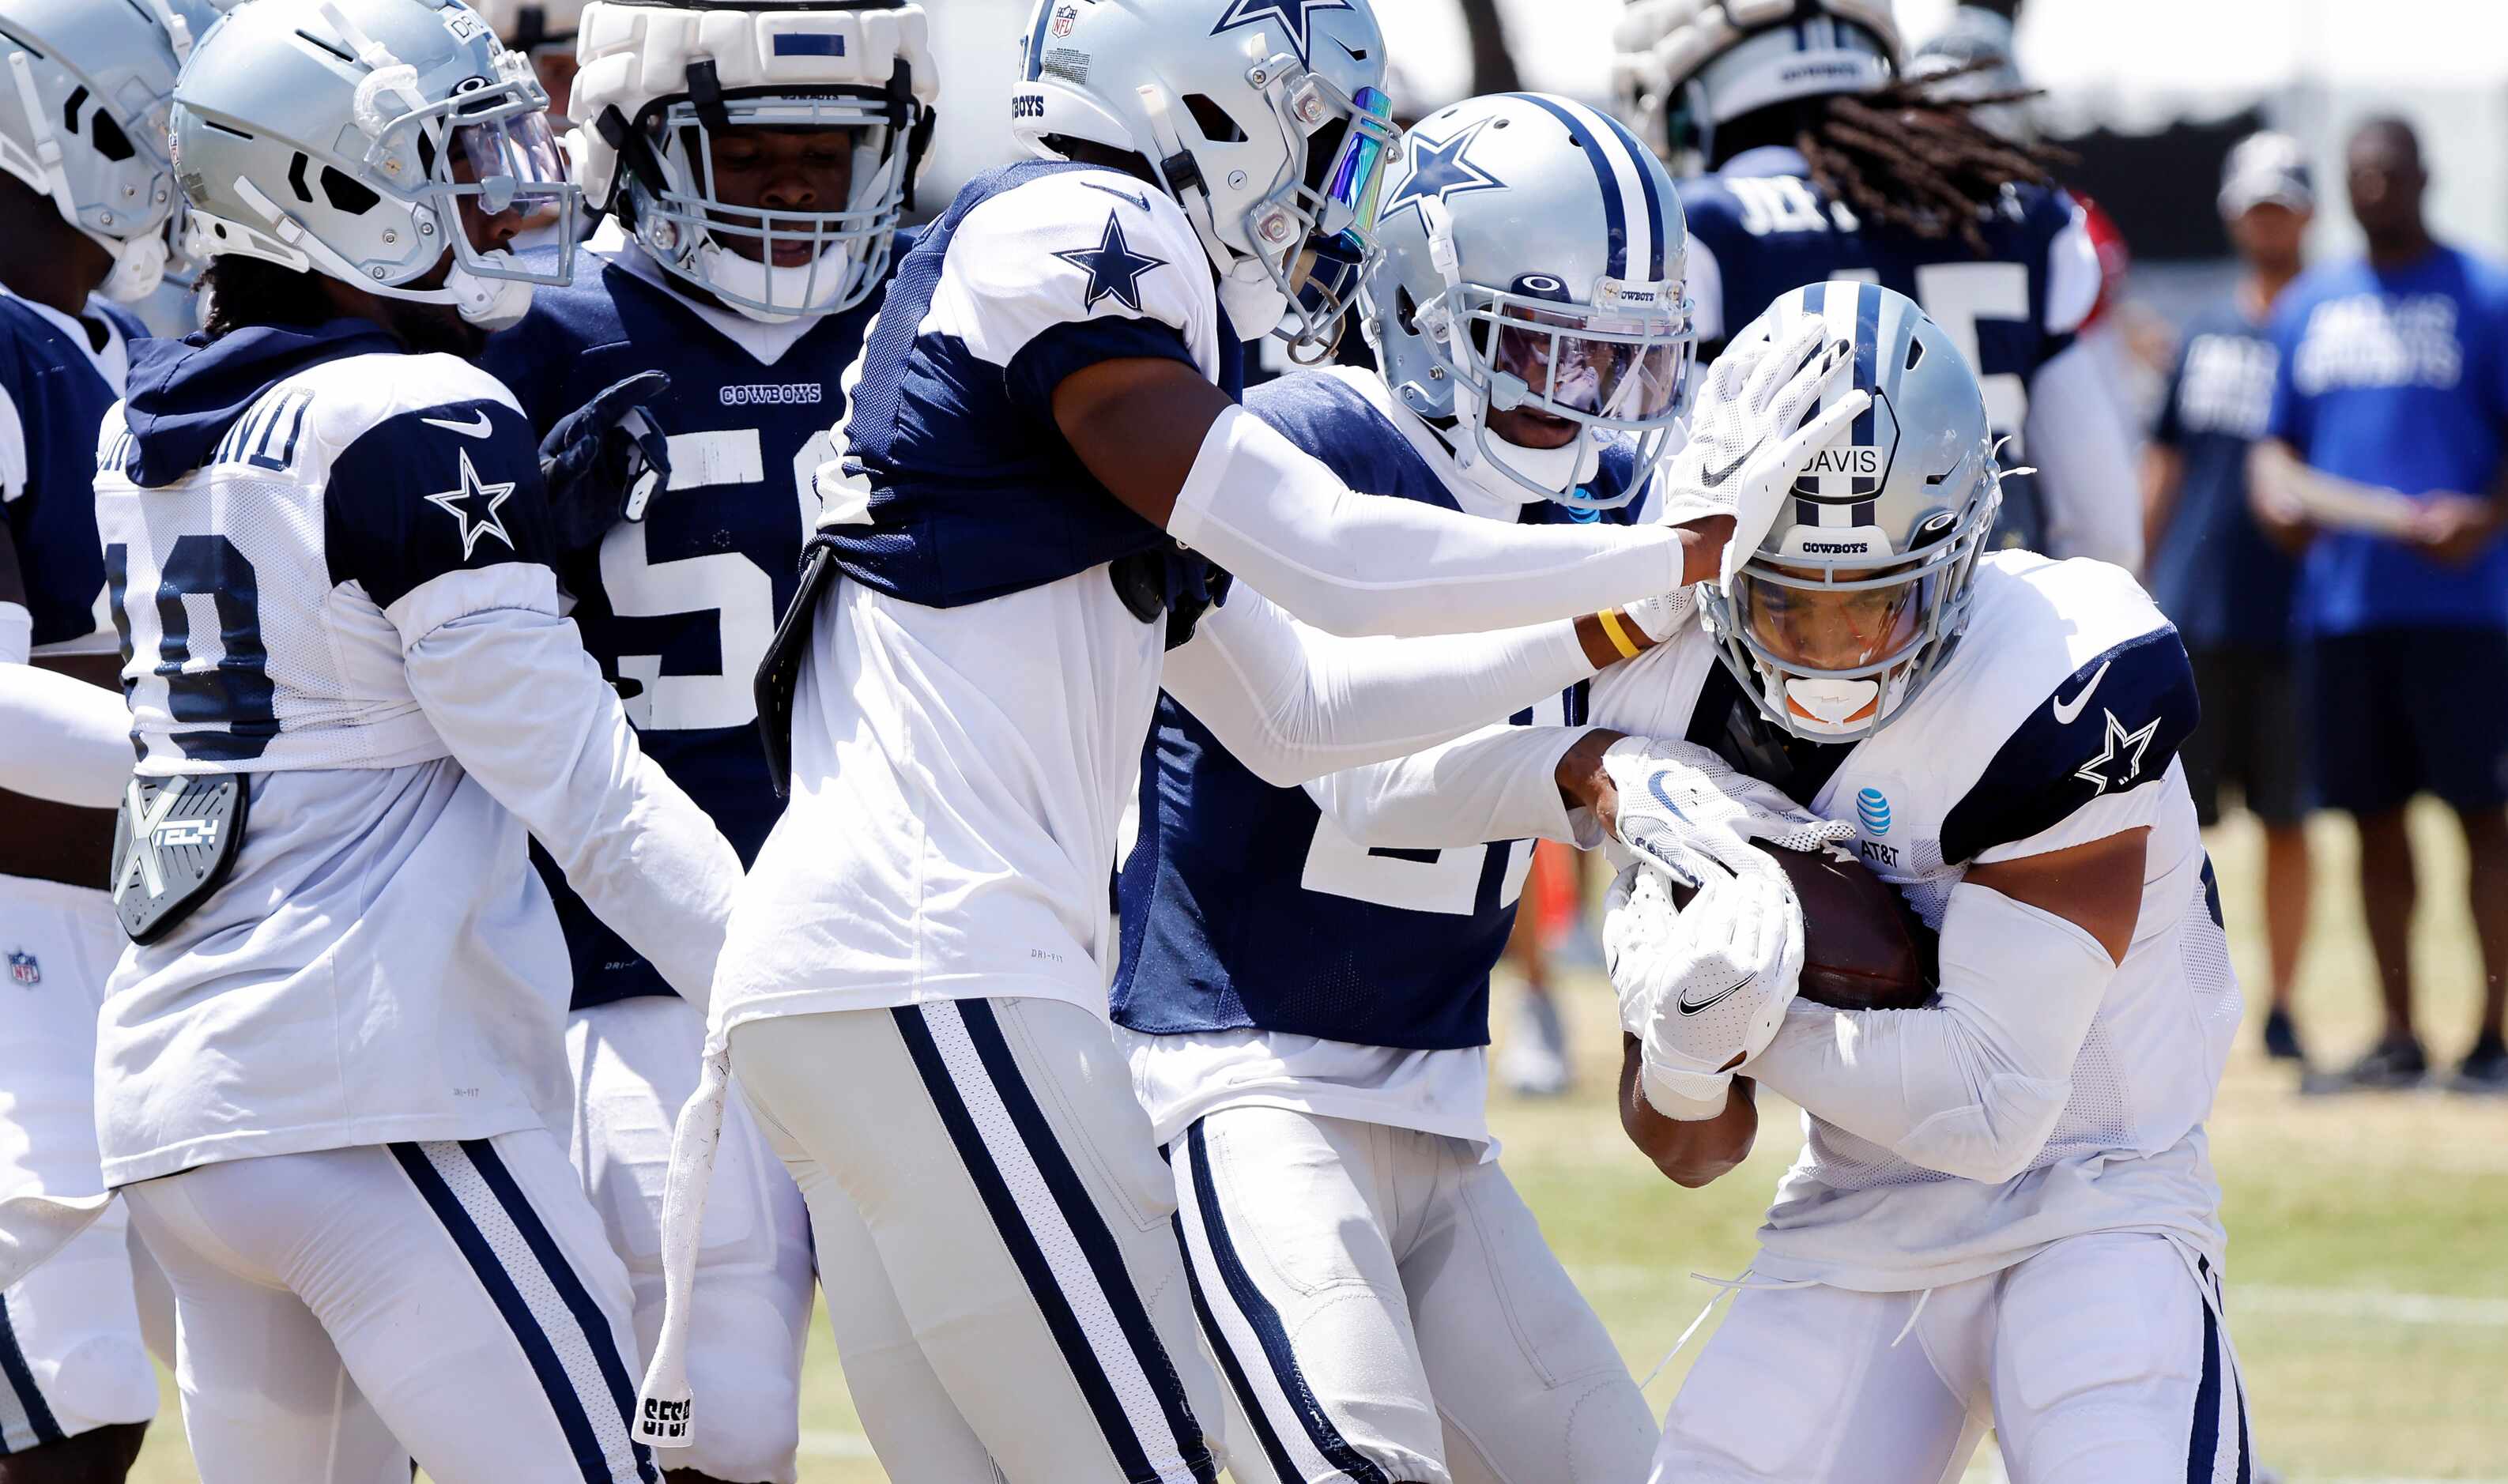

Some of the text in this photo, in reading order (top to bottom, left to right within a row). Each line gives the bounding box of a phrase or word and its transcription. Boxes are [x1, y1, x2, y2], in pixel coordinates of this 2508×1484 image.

[1054, 18, 1070, 34] NFL
[1013, 95, 1044, 119] BOYS
[1620, 290, 1655, 302] OWBOYS
[719, 383, 822, 405] COWBOYS
[1802, 542, 1868, 554] COWBOYS
[1861, 839, 1899, 868] AT&T
